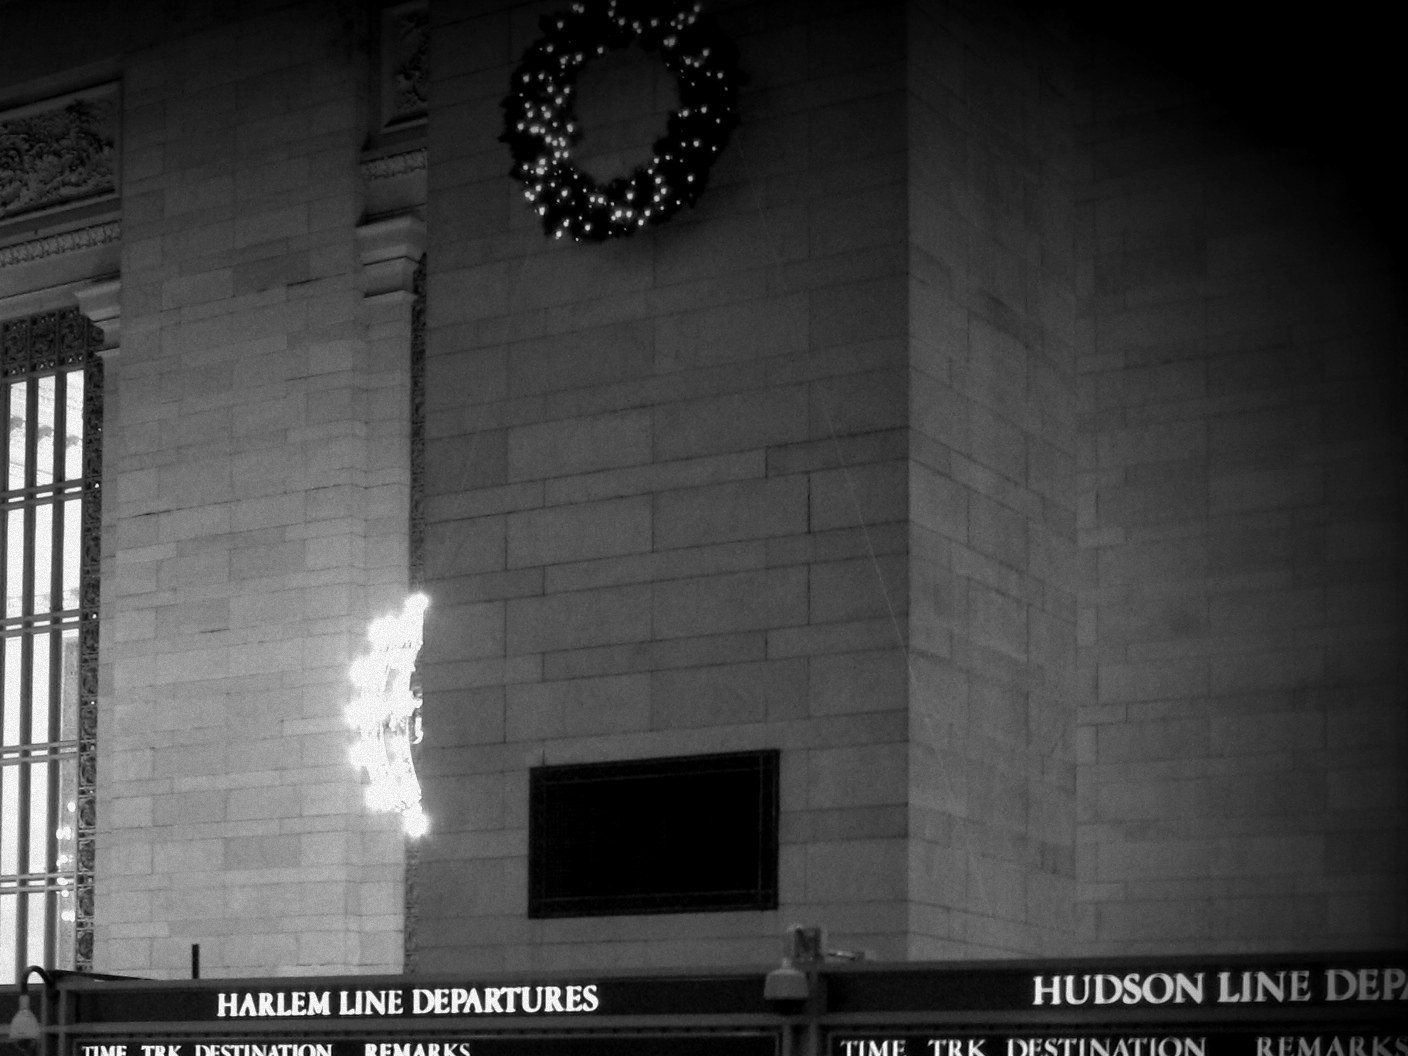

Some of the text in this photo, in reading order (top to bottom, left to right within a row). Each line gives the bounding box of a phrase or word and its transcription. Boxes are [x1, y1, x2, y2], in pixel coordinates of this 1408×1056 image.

[216, 984, 599, 1018] HARLEM LINE DEPARTURES
[1031, 972, 1205, 1006] HUDSON
[1217, 970, 1311, 1003] LINE
